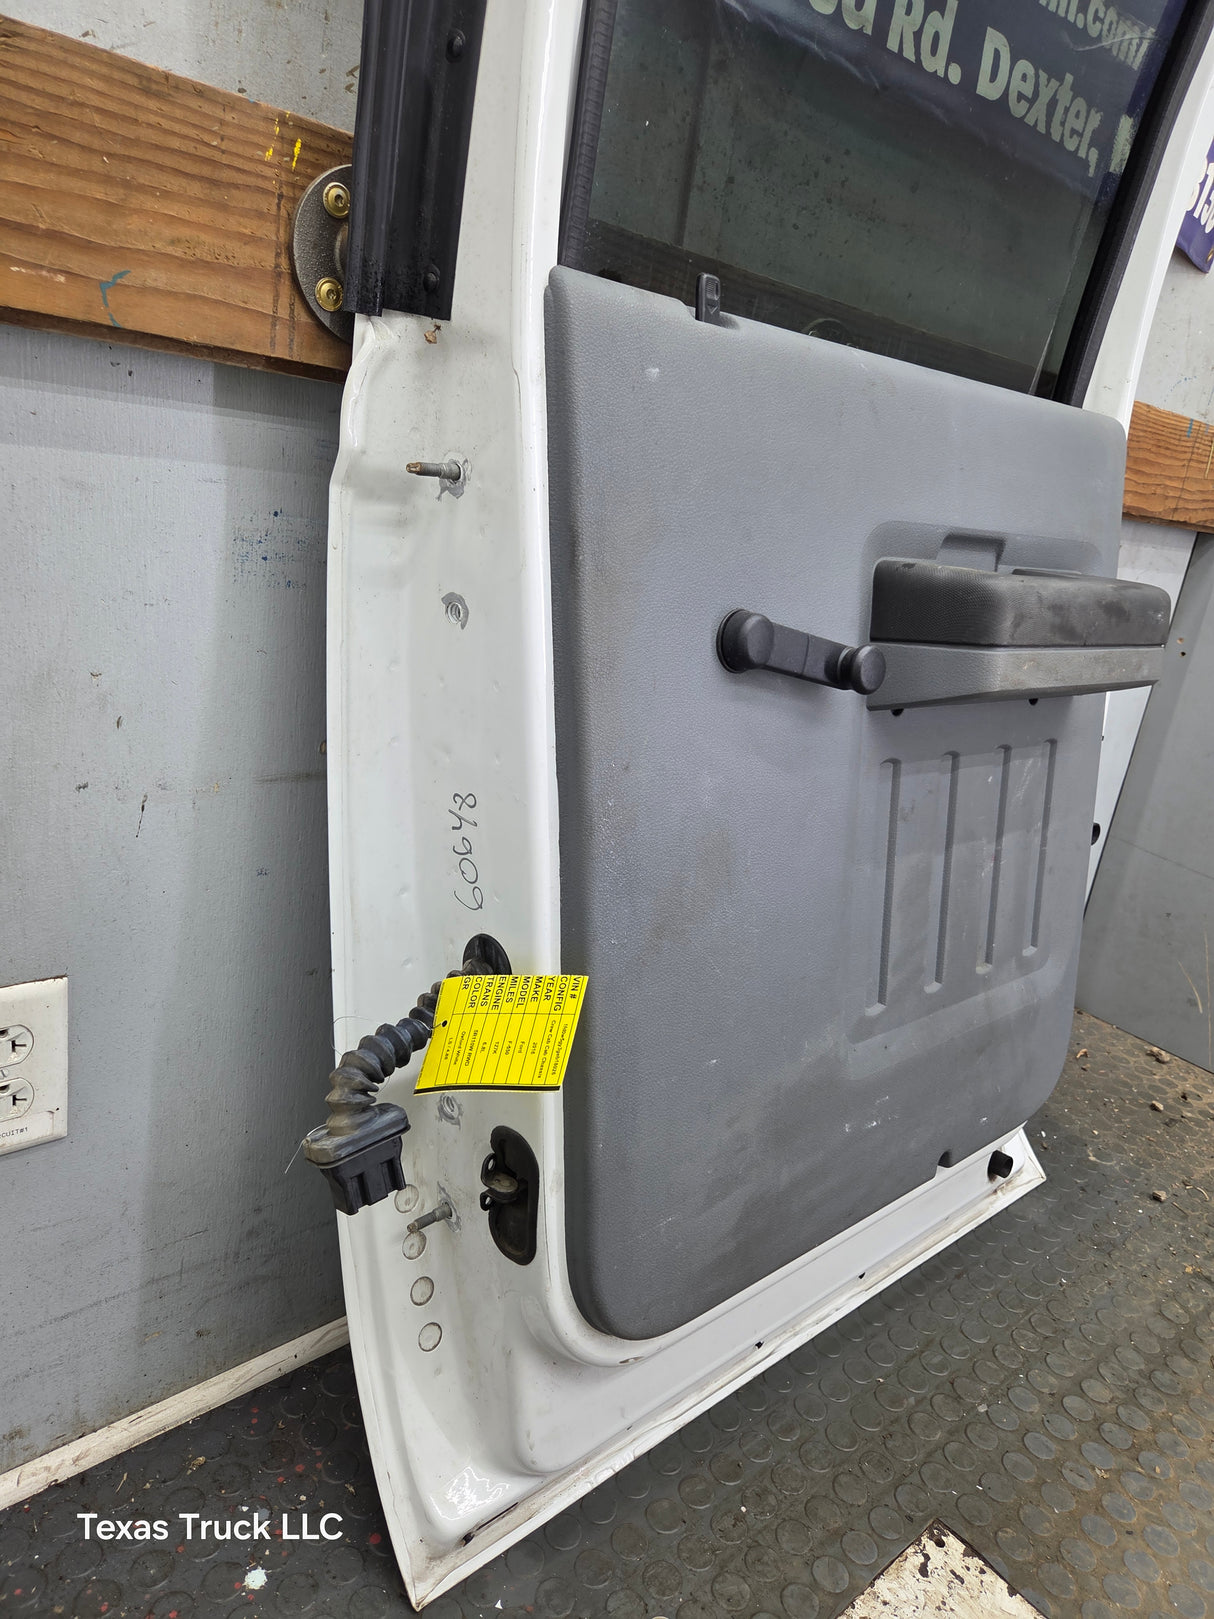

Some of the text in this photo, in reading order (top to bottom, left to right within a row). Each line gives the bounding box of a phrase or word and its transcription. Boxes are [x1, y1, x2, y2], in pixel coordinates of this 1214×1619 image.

[886, 0, 962, 85] Rd.
[975, 26, 1103, 177] Dexter,
[462, 977, 470, 989] GR
[467, 977, 482, 1008] COLOR
[480, 977, 493, 1006] TRANS
[491, 977, 505, 1010] ENGINE
[505, 977, 518, 1002] MILES
[516, 976, 530, 1007] MODEL
[530, 976, 543, 1002] MAKE
[542, 976, 555, 1000] YEAR
[552, 976, 568, 1011] CONFIG
[570, 976, 581, 990] VIN
[517, 1041, 525, 1053] Ford
[0, 1126, 28, 1139] CUIT#1
